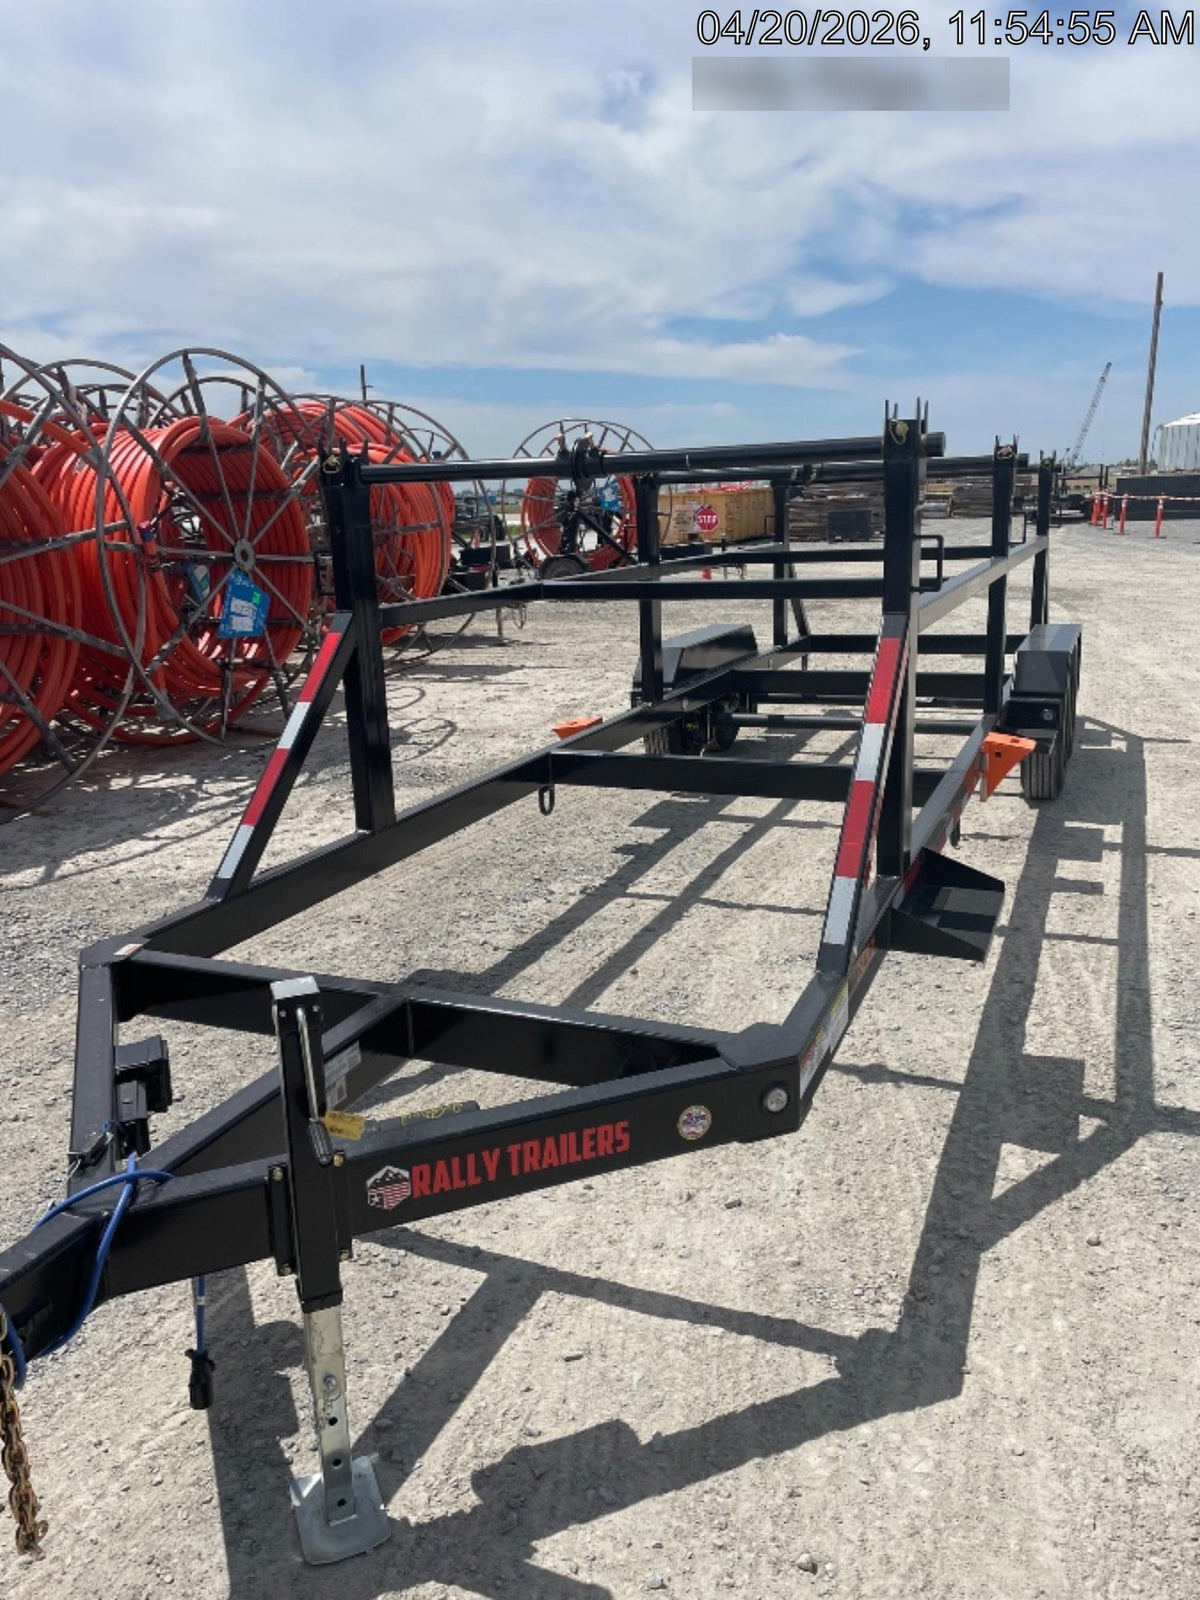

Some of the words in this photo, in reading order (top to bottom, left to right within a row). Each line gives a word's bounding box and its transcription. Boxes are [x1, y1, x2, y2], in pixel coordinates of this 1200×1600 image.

[698, 514, 717, 524] STOP
[411, 1149, 499, 1199] RALLY
[507, 1121, 631, 1175] TRAILERS
